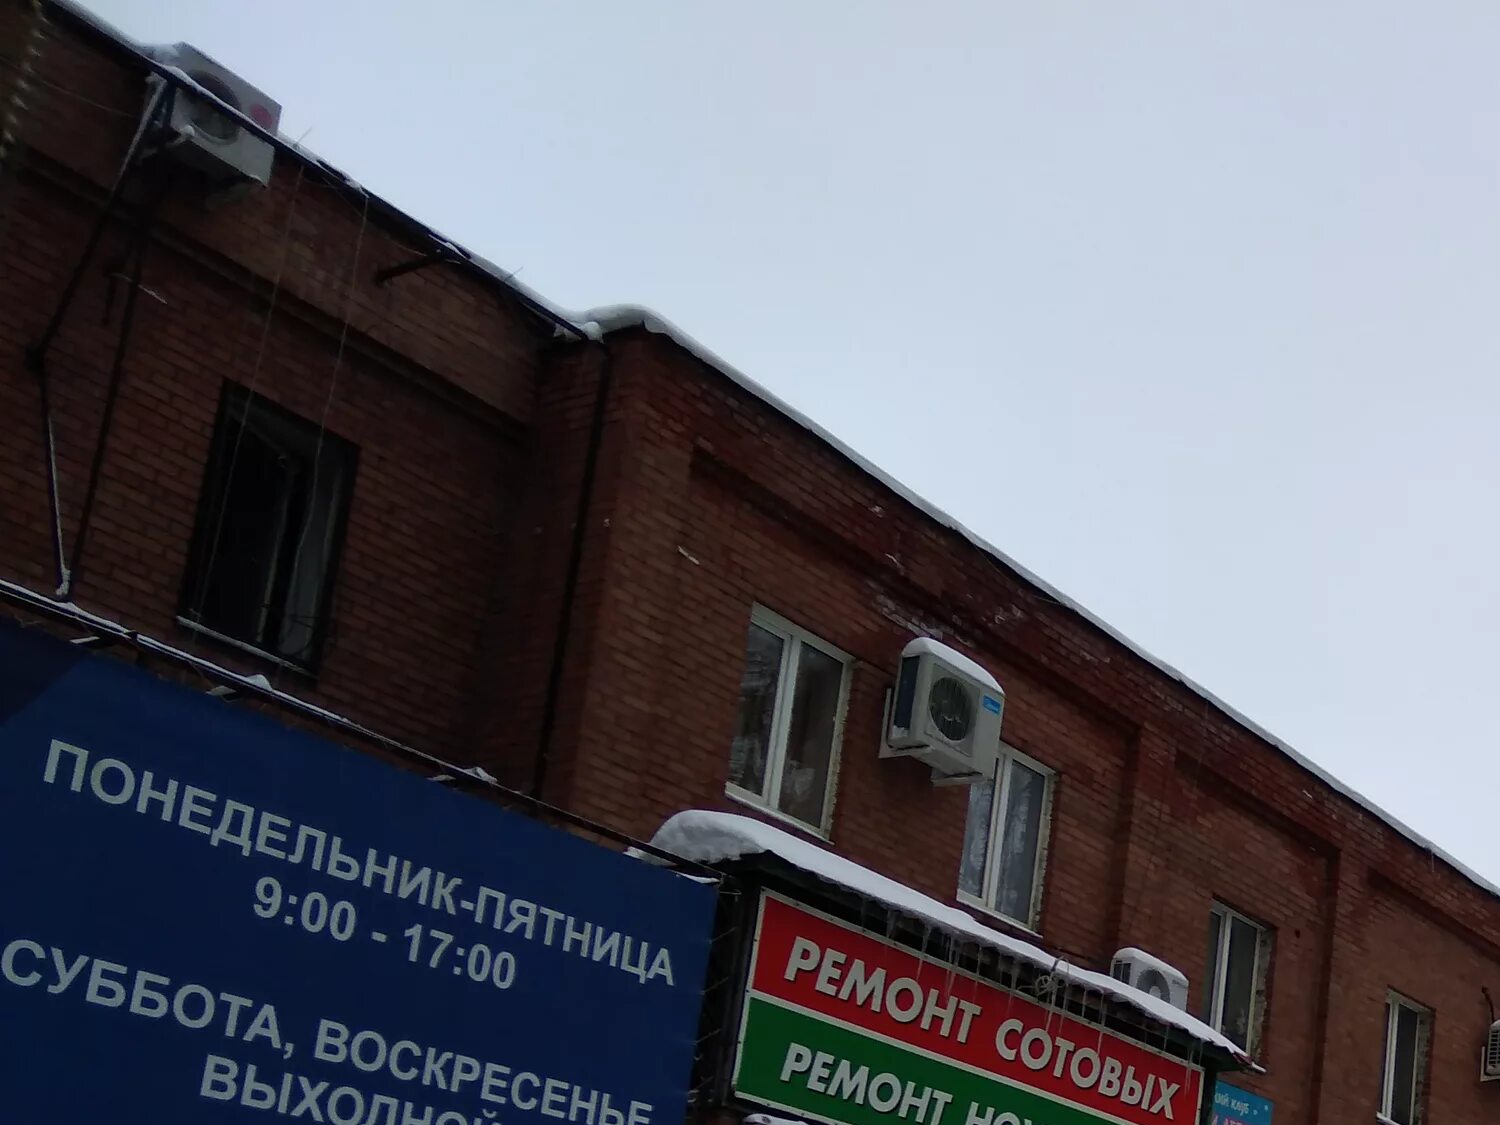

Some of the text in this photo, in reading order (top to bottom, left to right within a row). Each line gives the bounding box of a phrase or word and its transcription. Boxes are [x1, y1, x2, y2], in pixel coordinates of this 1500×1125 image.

[42, 739, 675, 986] ПОНЕДЕЛЬНИК-ПЯТНИЦА
[252, 876, 356, 942] 9:00
[403, 924, 517, 990] 17:00
[0, 938, 295, 1057] СУББОТА,
[784, 936, 1181, 1121] РЕМОНТ СОТОВЫХ
